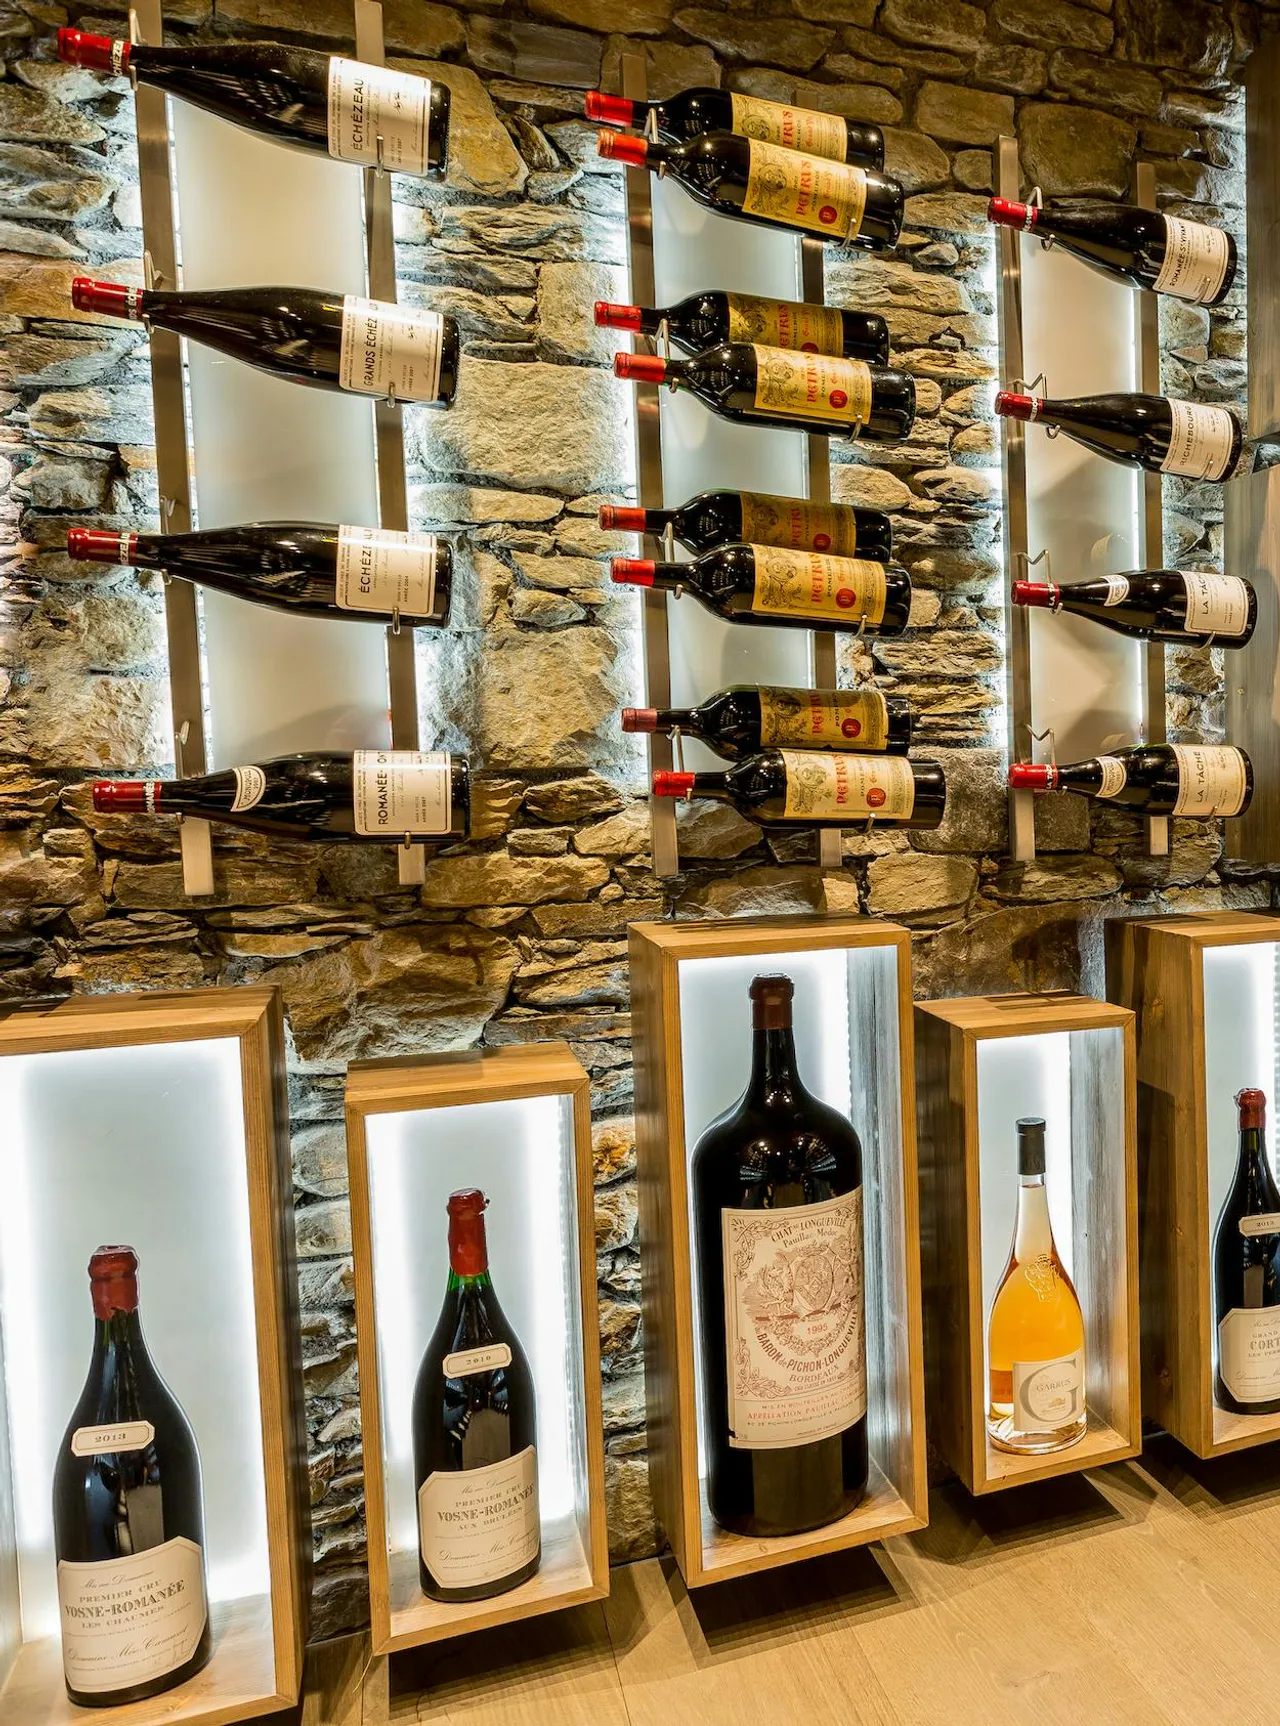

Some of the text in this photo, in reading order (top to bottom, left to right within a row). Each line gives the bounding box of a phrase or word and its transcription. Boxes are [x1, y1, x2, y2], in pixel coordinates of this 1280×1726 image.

[1180, 405, 1194, 466] RICHEBOURG
[1201, 601, 1209, 615] LA
[1193, 751, 1205, 803] LA TÂCHE
[800, 1217, 848, 1231] LONGUEVILLE
[807, 1323, 828, 1335] 1995
[757, 1332, 783, 1362] BARON
[789, 1364, 839, 1383] BORDEAUX
[747, 1400, 839, 1420] APPELLATION PAUILLAC
[94, 1432, 127, 1443] 2013
[437, 1483, 535, 1522] VOSNE-ROMANÉE
[455, 1493, 502, 1508] PREMIER
[65, 1579, 185, 1618] VOSNE-ROMANÉE
[80, 1579, 161, 1603] PREMIER CRU
[82, 1605, 165, 1629] LES CHAUMES
